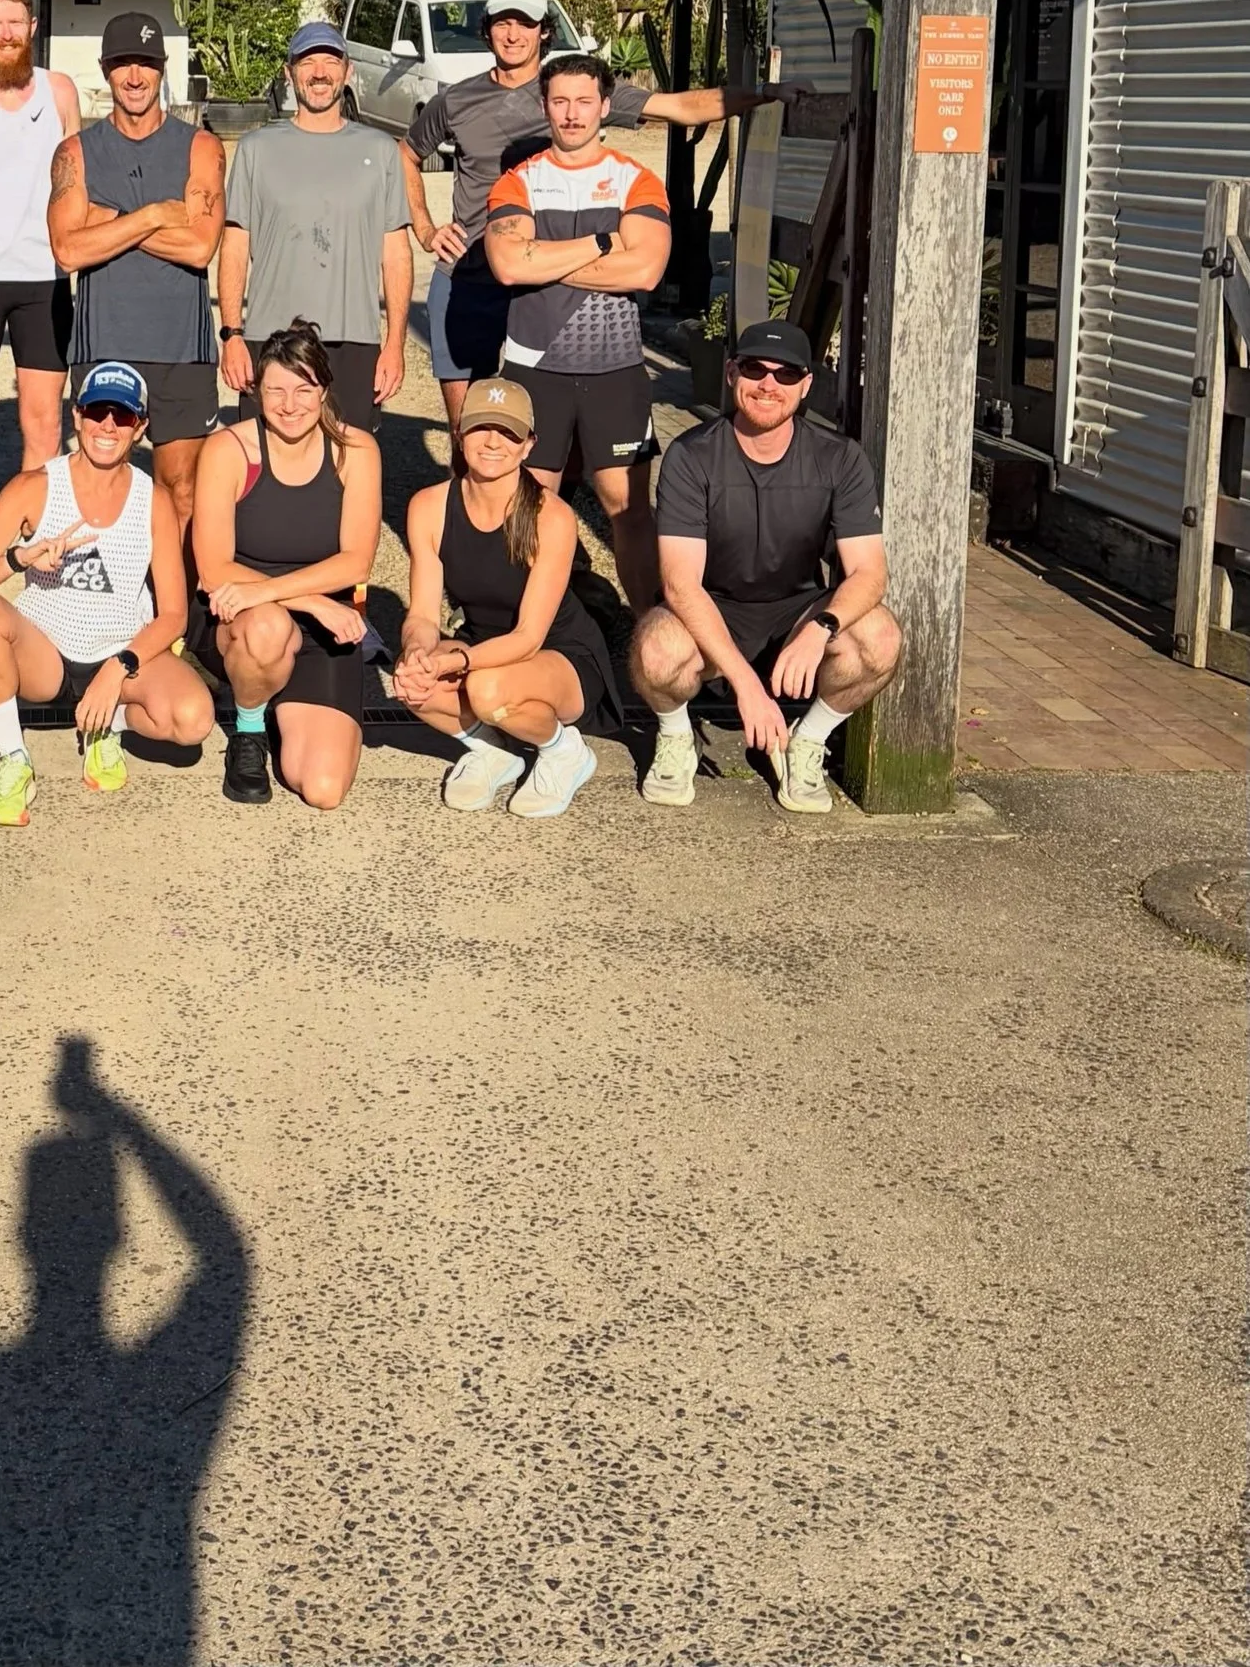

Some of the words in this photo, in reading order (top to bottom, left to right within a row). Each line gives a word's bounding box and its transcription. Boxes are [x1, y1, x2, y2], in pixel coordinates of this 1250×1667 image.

[927, 53, 942, 64] NO
[944, 53, 979, 65] ENTRY
[930, 78, 973, 89] VISITORS
[939, 92, 964, 102] CARS
[938, 105, 963, 116] ONLY
